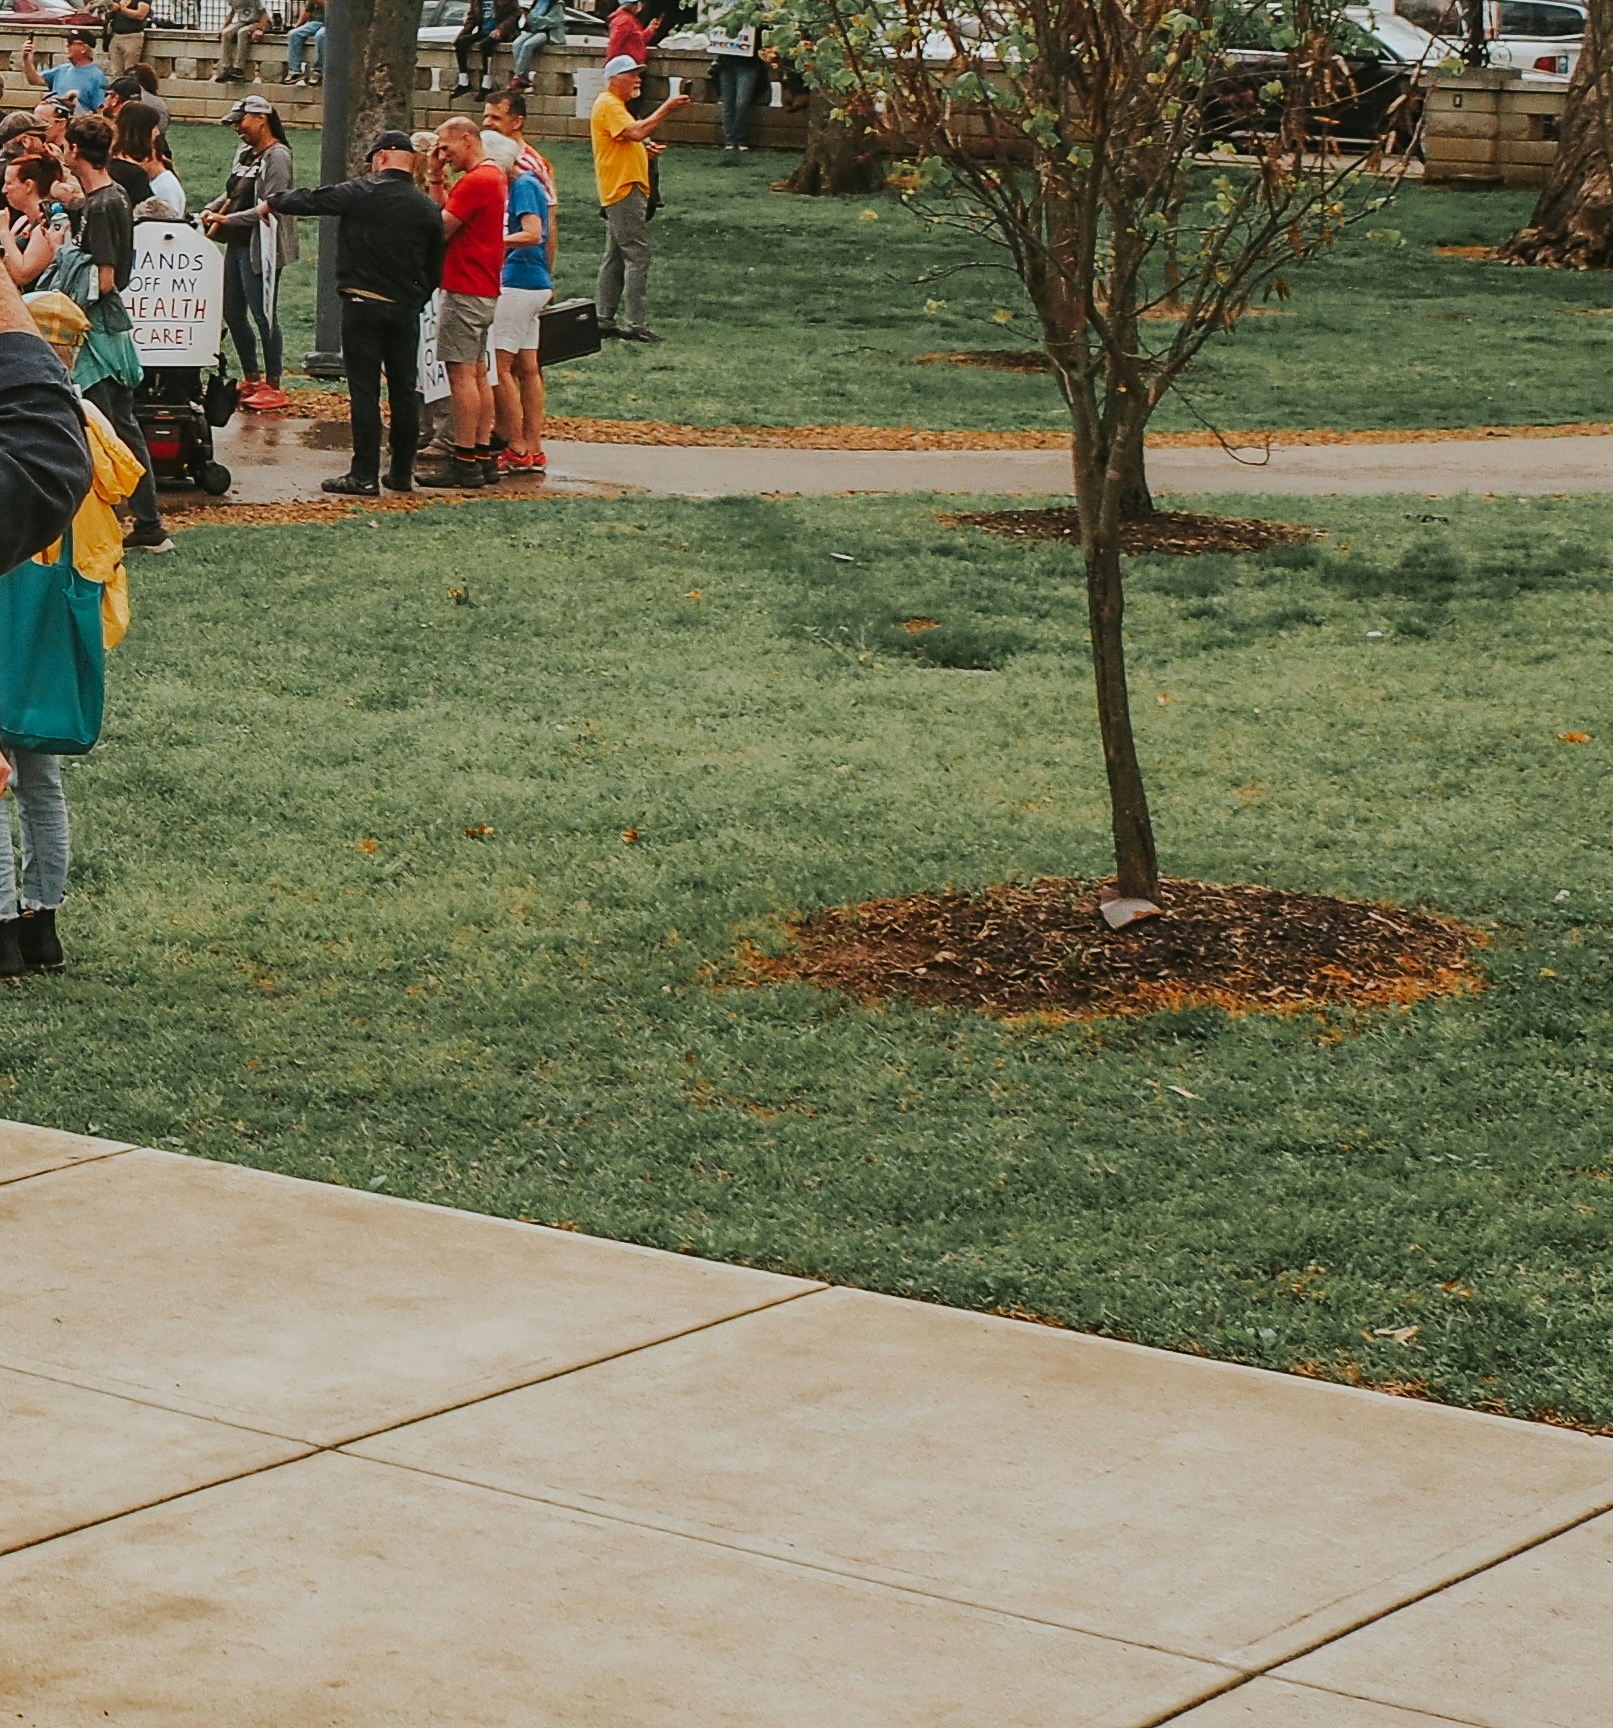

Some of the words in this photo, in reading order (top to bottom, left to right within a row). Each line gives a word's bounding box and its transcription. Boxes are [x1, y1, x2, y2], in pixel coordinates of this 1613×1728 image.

[129, 276, 161, 292] OFF
[171, 277, 197, 293] MY
[133, 326, 193, 346] CARE!
